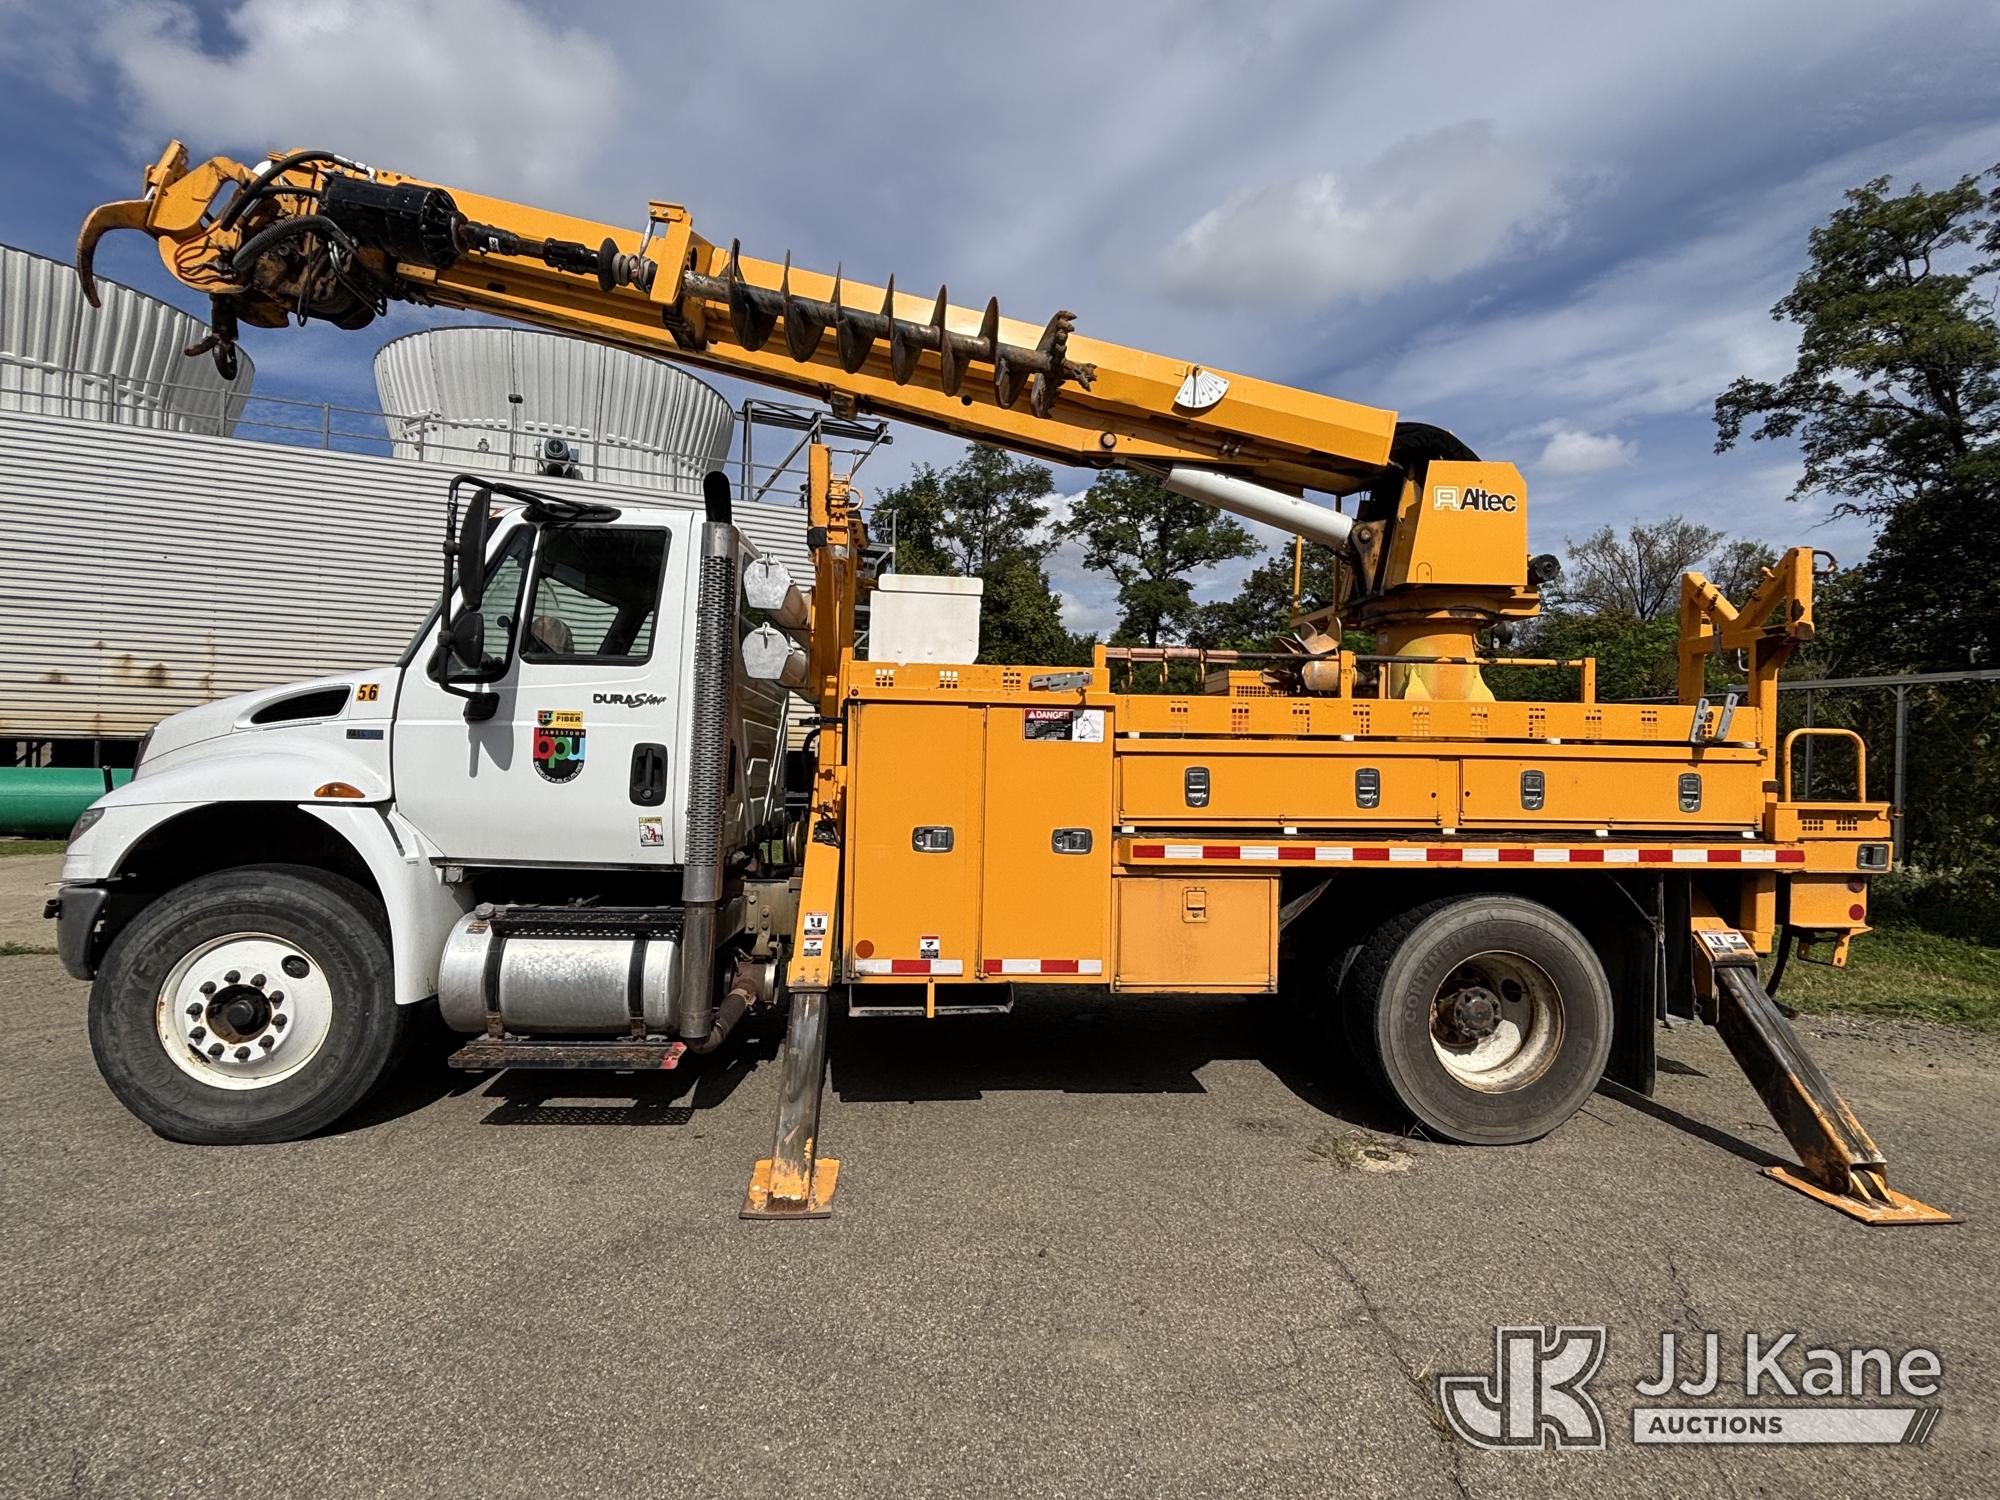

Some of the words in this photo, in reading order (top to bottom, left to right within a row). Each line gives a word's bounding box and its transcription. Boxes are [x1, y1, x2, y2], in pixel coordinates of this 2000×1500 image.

[1460, 488, 1516, 512] Altec
[358, 684, 378, 700] 56
[1036, 711, 1070, 719] DANGER
